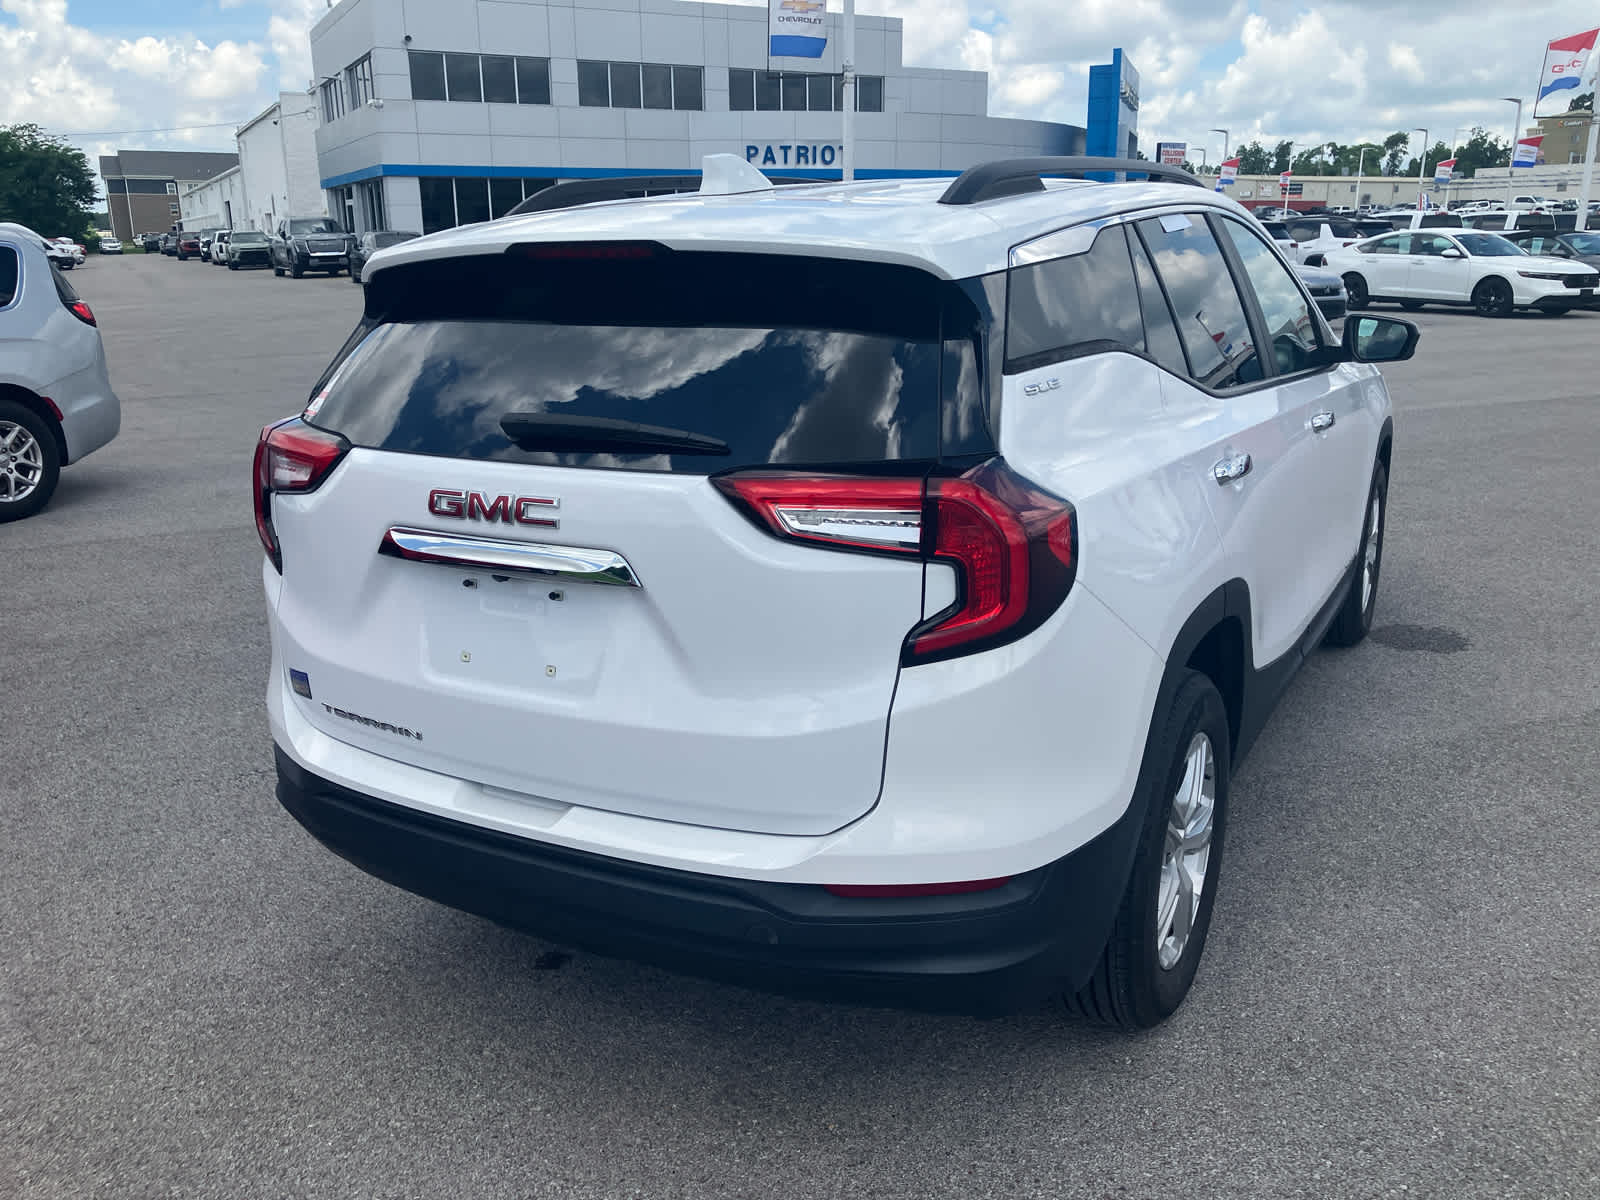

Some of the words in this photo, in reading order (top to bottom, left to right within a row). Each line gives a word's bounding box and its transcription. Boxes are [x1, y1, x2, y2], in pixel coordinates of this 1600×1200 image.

[777, 15, 823, 25] CHEVROLET
[745, 144, 844, 166] PATRIO
[1023, 377, 1062, 397] SLE
[428, 487, 561, 529] GMC
[321, 701, 423, 741] TERRAIN
